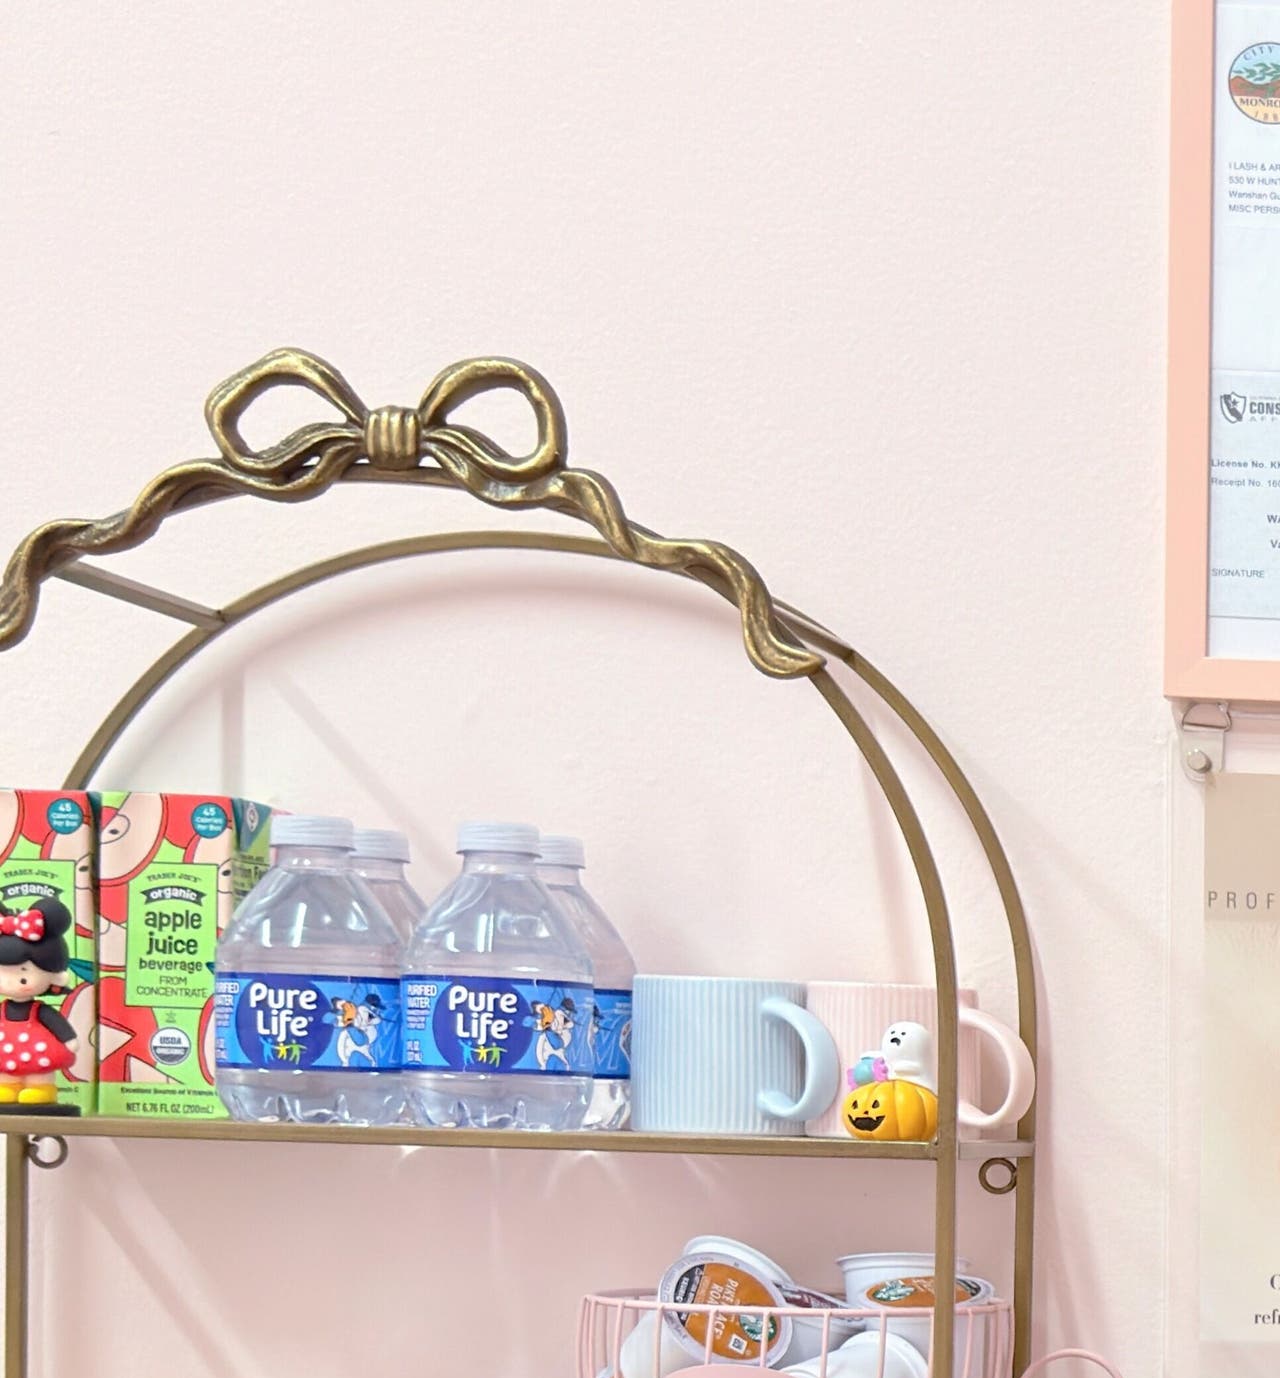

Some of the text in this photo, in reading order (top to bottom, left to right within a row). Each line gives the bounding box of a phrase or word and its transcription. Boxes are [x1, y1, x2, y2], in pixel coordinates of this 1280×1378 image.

[1233, 161, 1258, 171] LASH
[1260, 162, 1266, 171] &
[1228, 175, 1244, 185] 530
[1245, 176, 1255, 184] W
[1228, 190, 1267, 200] Wanshan
[1228, 203, 1251, 213] MISC
[1211, 459, 1248, 468] License
[1211, 477, 1245, 487] Receipt
[1212, 568, 1265, 578] SIGNATURE
[7, 884, 55, 897] organic
[149, 887, 197, 901] organic
[144, 910, 202, 932] apple
[146, 931, 198, 955] juice
[139, 958, 203, 974] beverage
[159, 975, 188, 986] FROM
[136, 985, 208, 999] CONCENTRATE
[249, 982, 318, 1011] Pure
[448, 985, 517, 1013] Pure
[257, 1010, 308, 1042] Life
[456, 1012, 508, 1046] Life
[160, 1036, 182, 1045] USDA
